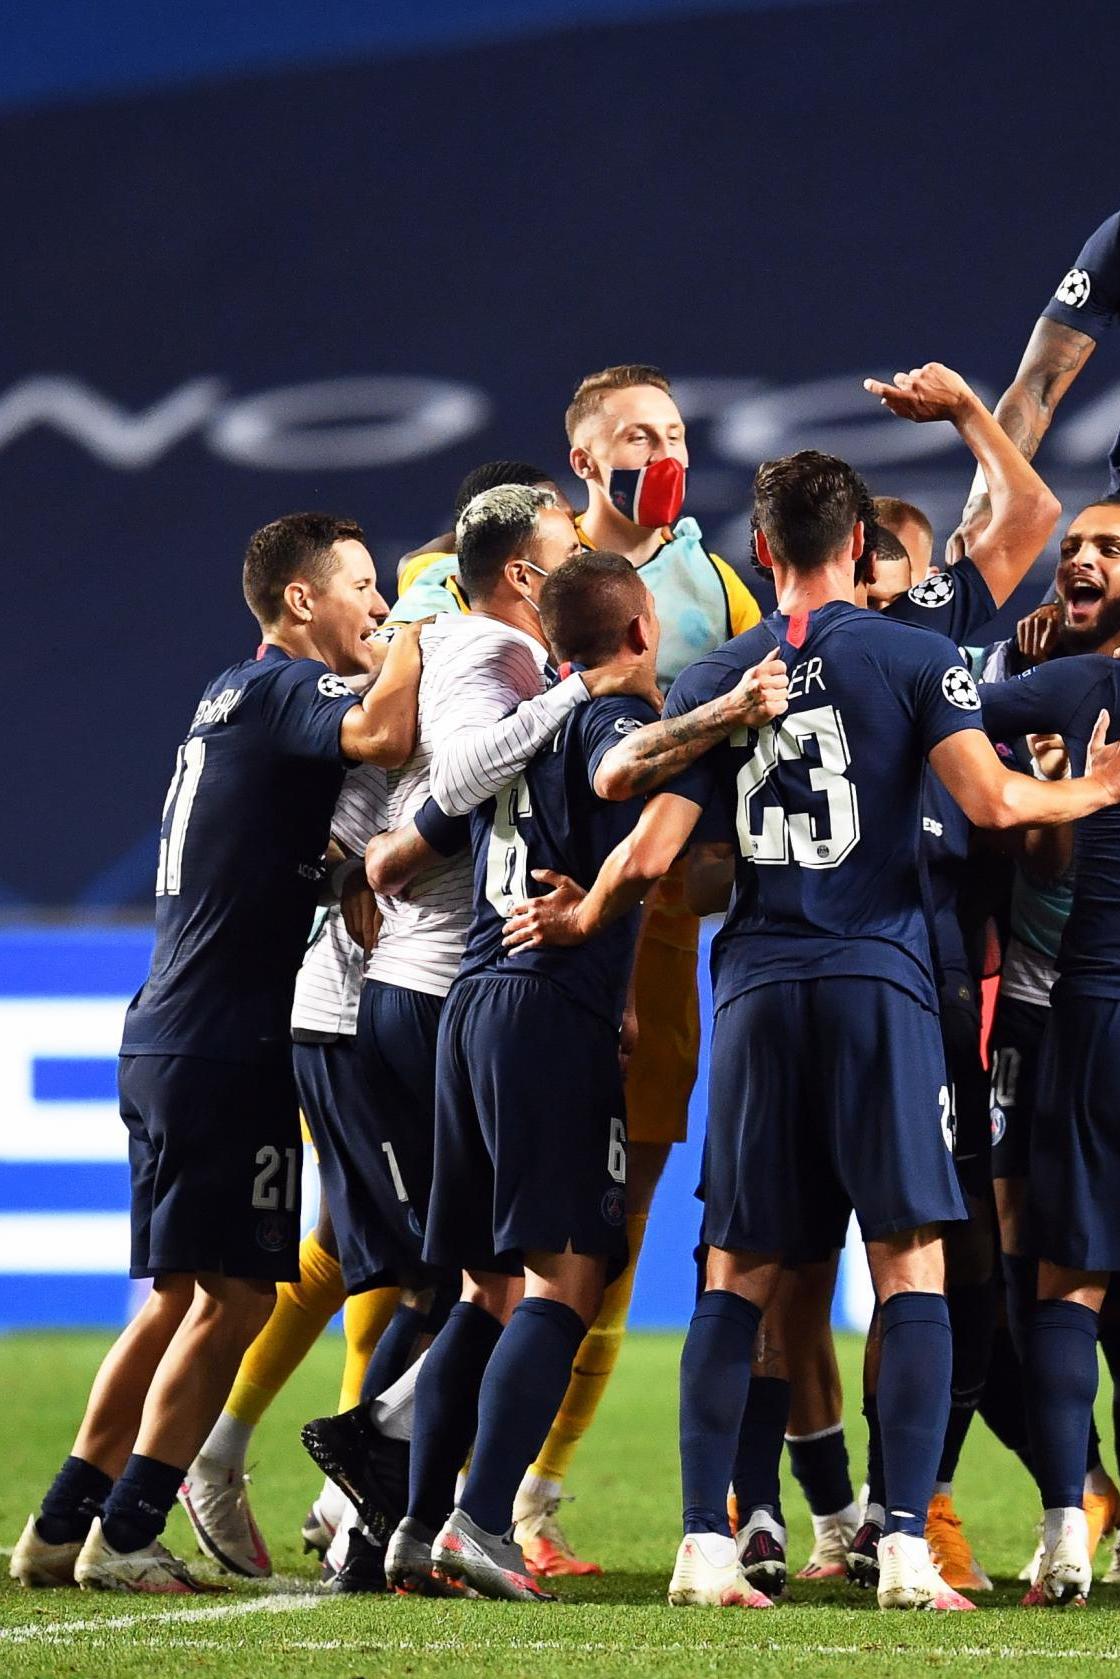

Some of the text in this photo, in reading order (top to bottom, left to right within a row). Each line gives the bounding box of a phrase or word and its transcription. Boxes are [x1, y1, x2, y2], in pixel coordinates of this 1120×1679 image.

[787, 656, 827, 701] ER
[729, 704, 861, 870] 23
[251, 1145, 298, 1212] 21
[381, 1141, 409, 1202] 1
[607, 1116, 627, 1184] 6
